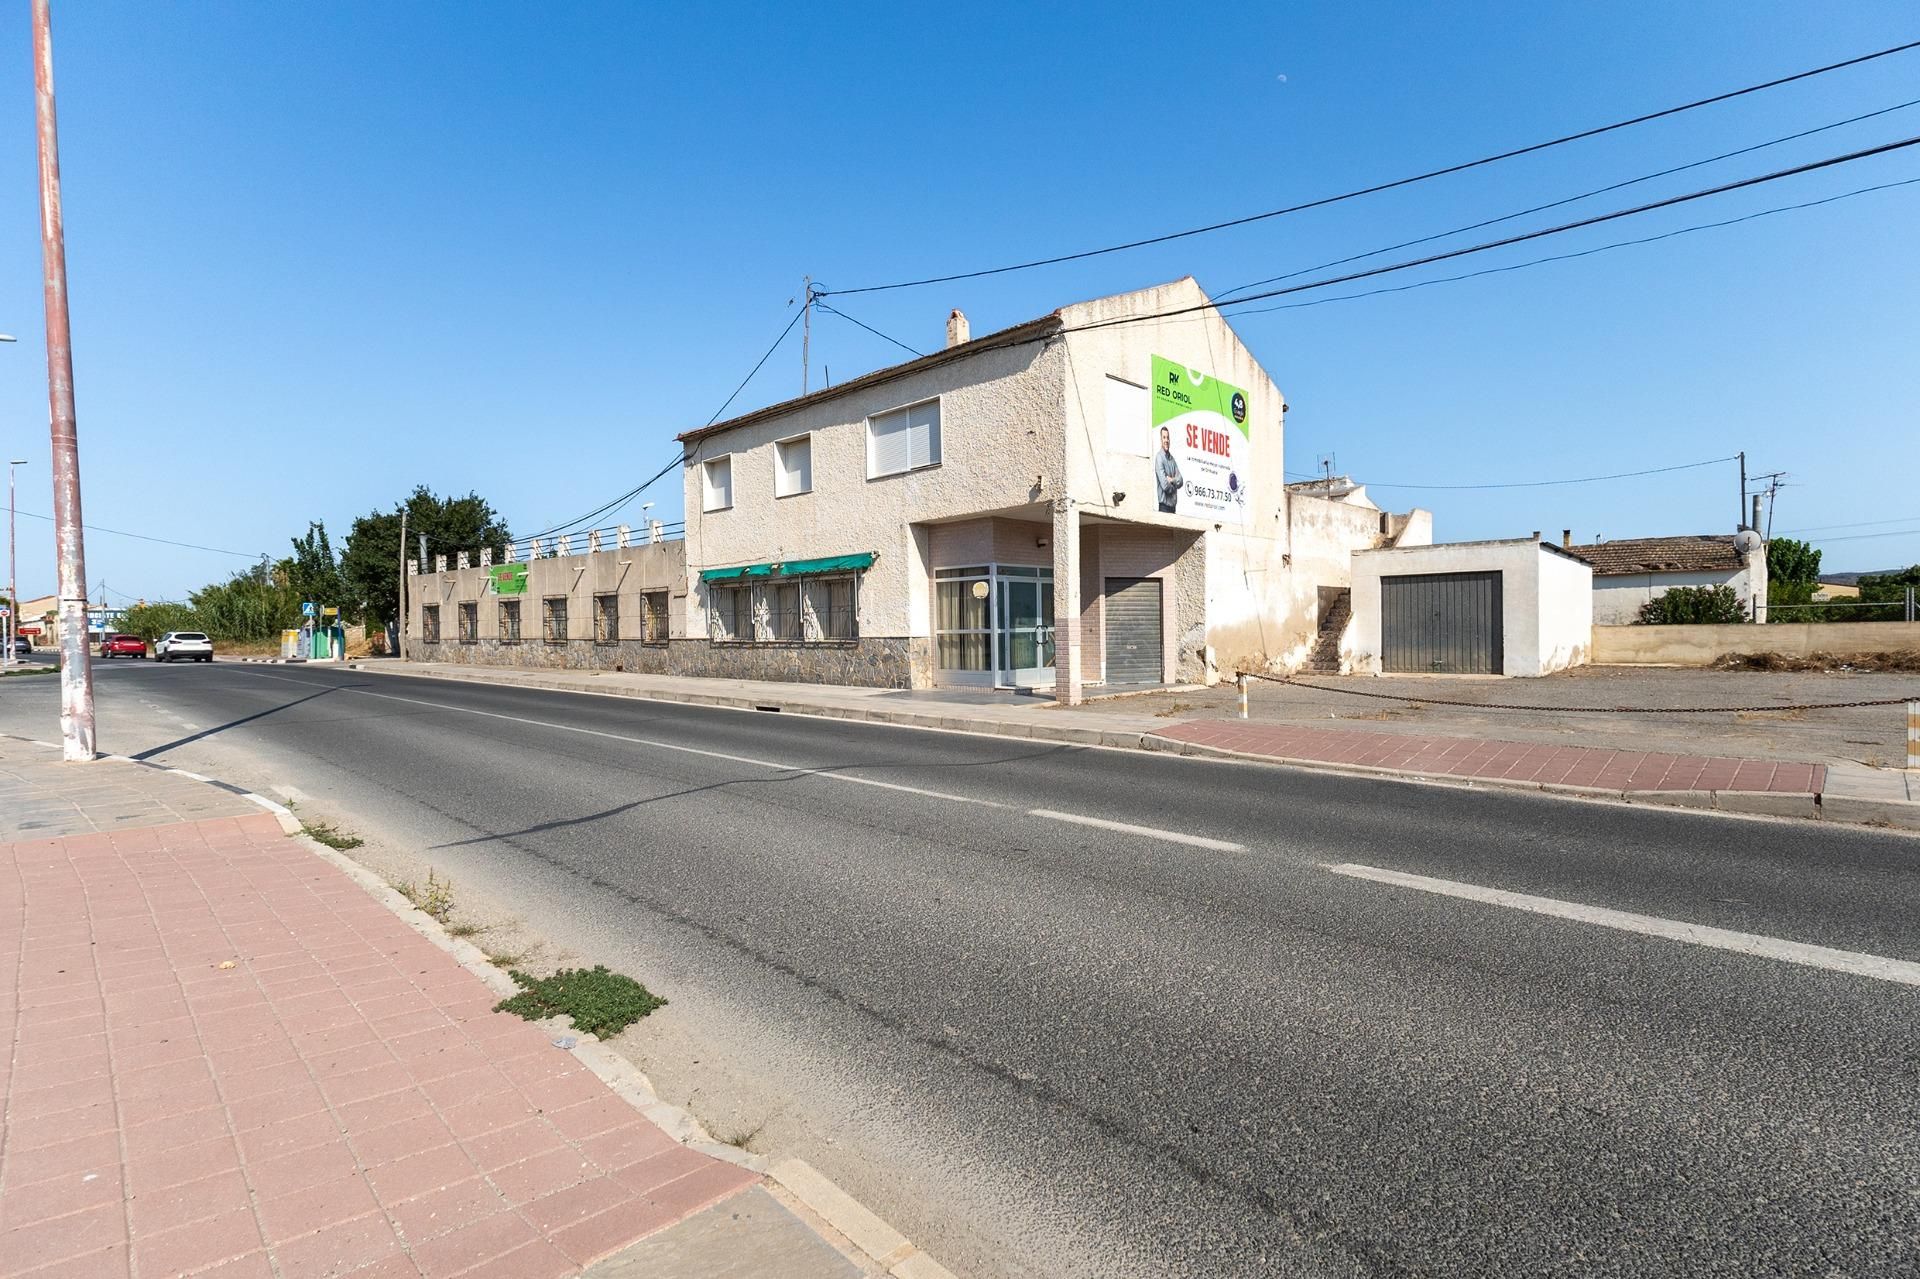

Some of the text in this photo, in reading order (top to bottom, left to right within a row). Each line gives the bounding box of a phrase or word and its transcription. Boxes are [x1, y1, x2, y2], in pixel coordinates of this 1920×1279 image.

[1156, 384, 1170, 396] RED
[1172, 390, 1192, 404] ORIOL
[1186, 424, 1230, 458] SE VENDE
[1194, 486, 1232, 502] 966.73.77.50
